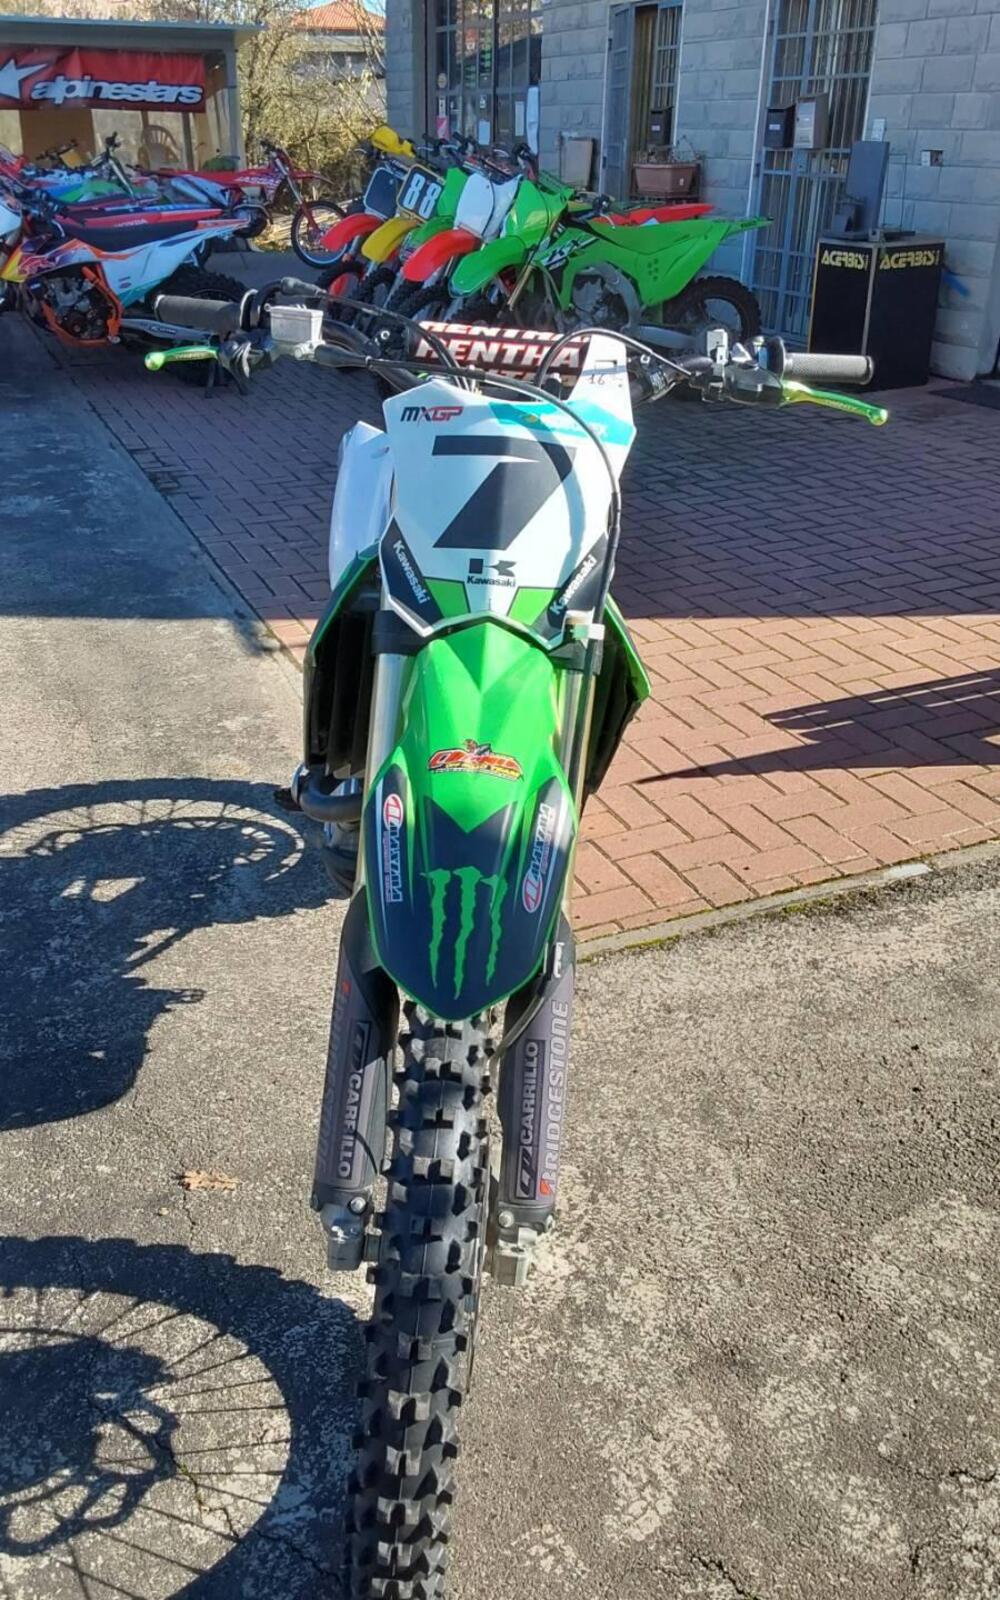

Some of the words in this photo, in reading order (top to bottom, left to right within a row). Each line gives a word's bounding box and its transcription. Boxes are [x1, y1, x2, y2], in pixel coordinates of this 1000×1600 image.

[31, 75, 203, 104] alpinestars
[403, 172, 442, 219] 88
[400, 406, 464, 425] MXGP
[432, 435, 577, 551] 7
[393, 540, 431, 604] Kawasaki
[467, 575, 516, 588] Kawasaki
[550, 554, 597, 615] Kawasaki
[520, 1041, 539, 1145] CARRILLO
[540, 1000, 569, 1195] BRIDGESTONE
